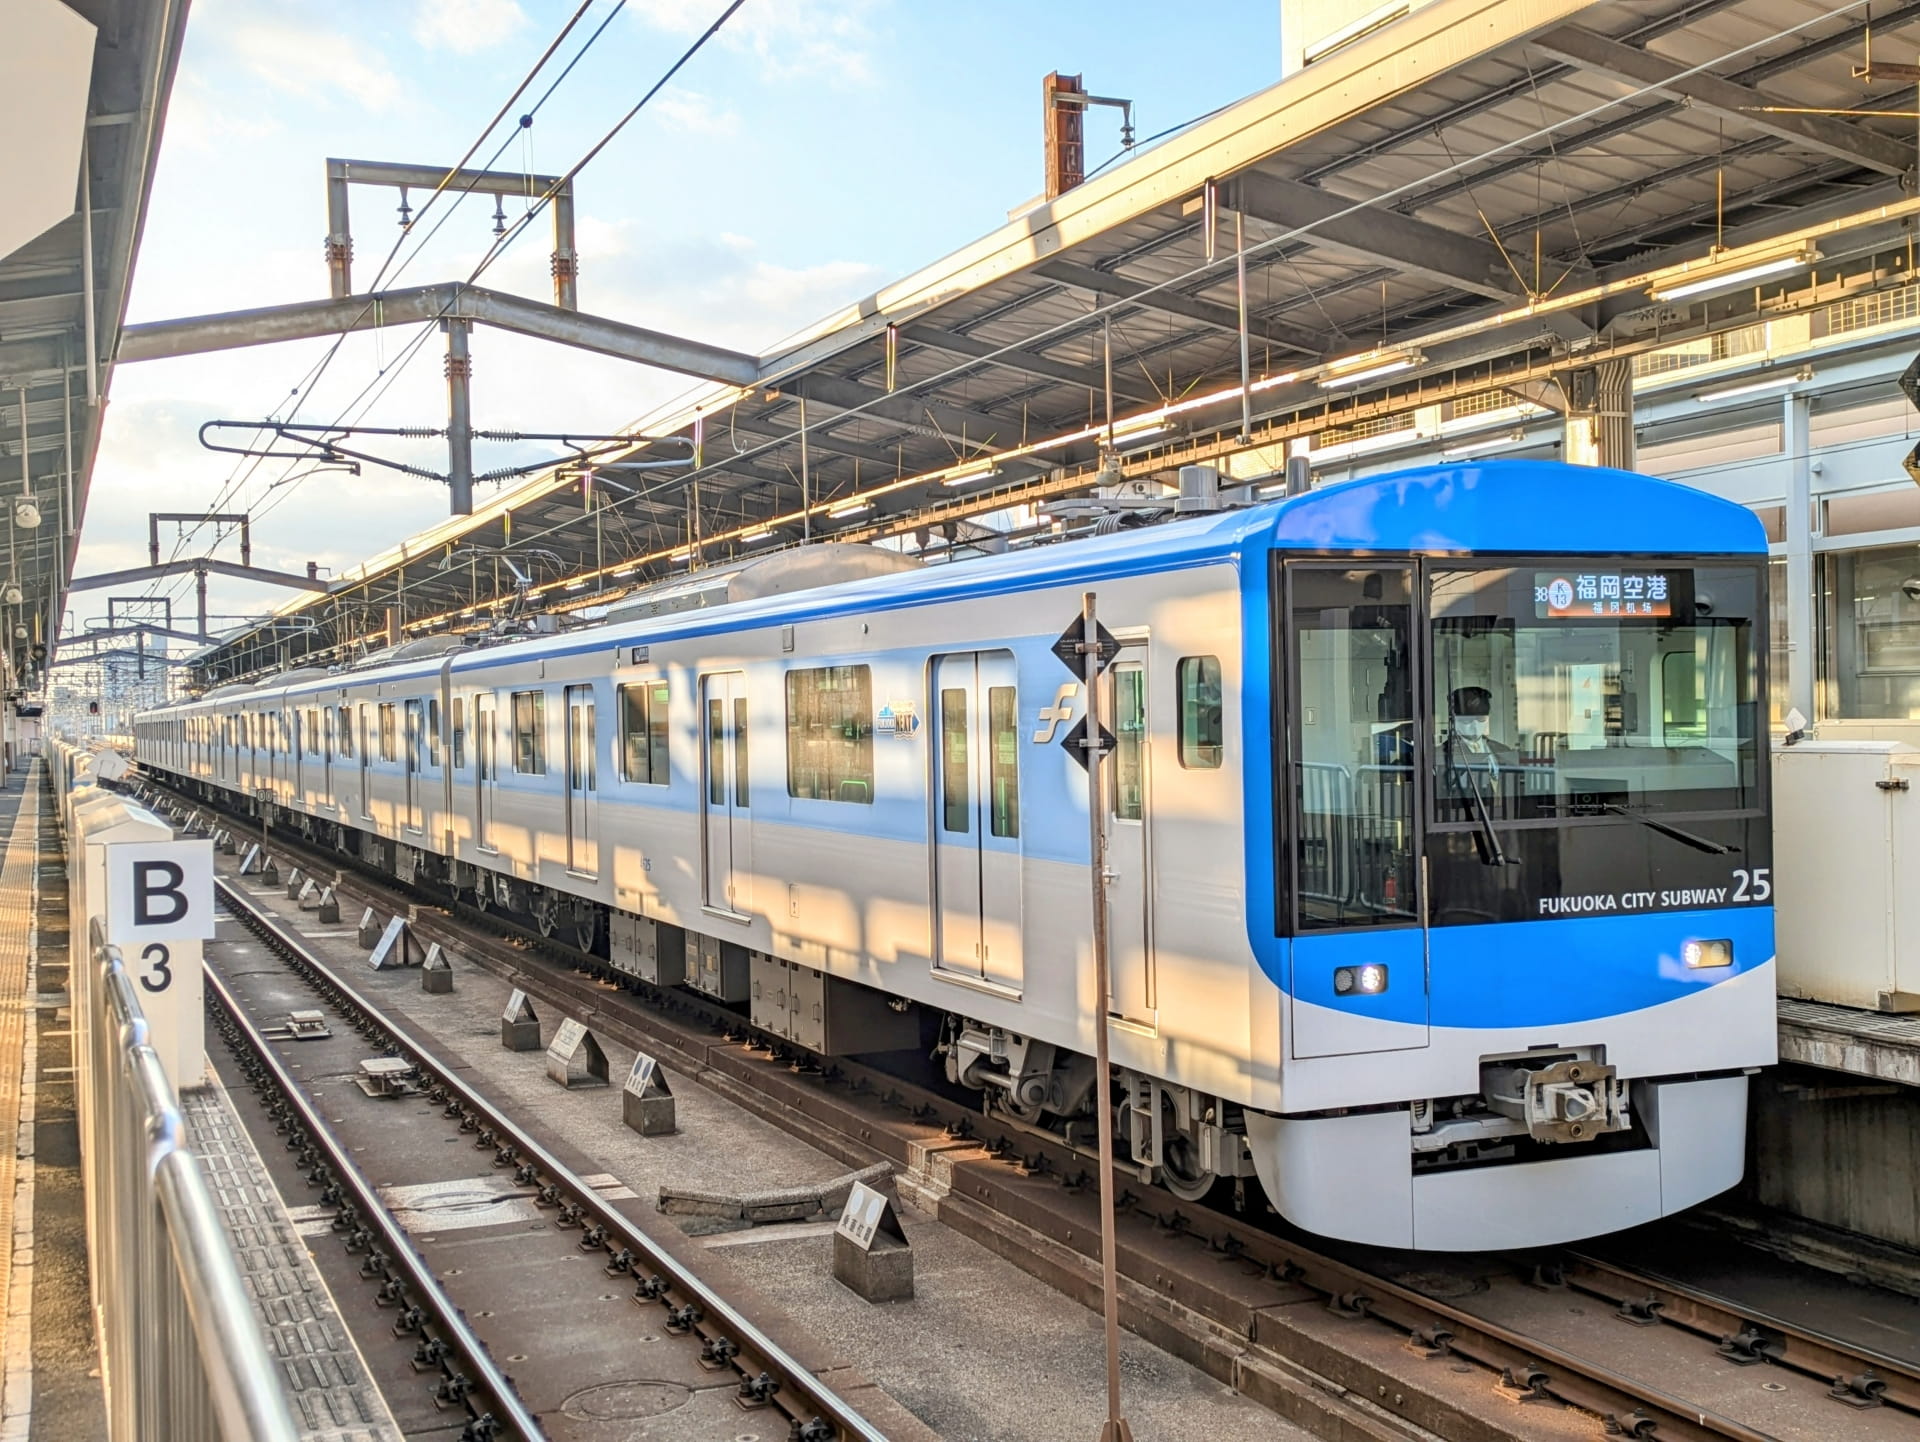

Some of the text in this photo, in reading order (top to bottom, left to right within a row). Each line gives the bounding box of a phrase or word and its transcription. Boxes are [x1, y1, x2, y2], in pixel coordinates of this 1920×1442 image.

[1555, 594, 1567, 605] 13
[1557, 582, 1565, 593] K
[1576, 575, 1668, 600] 福岡空港
[132, 860, 189, 926] B
[1539, 868, 1771, 914] FUKUOKA CITY SUBWAY 25
[140, 943, 172, 992] 3
